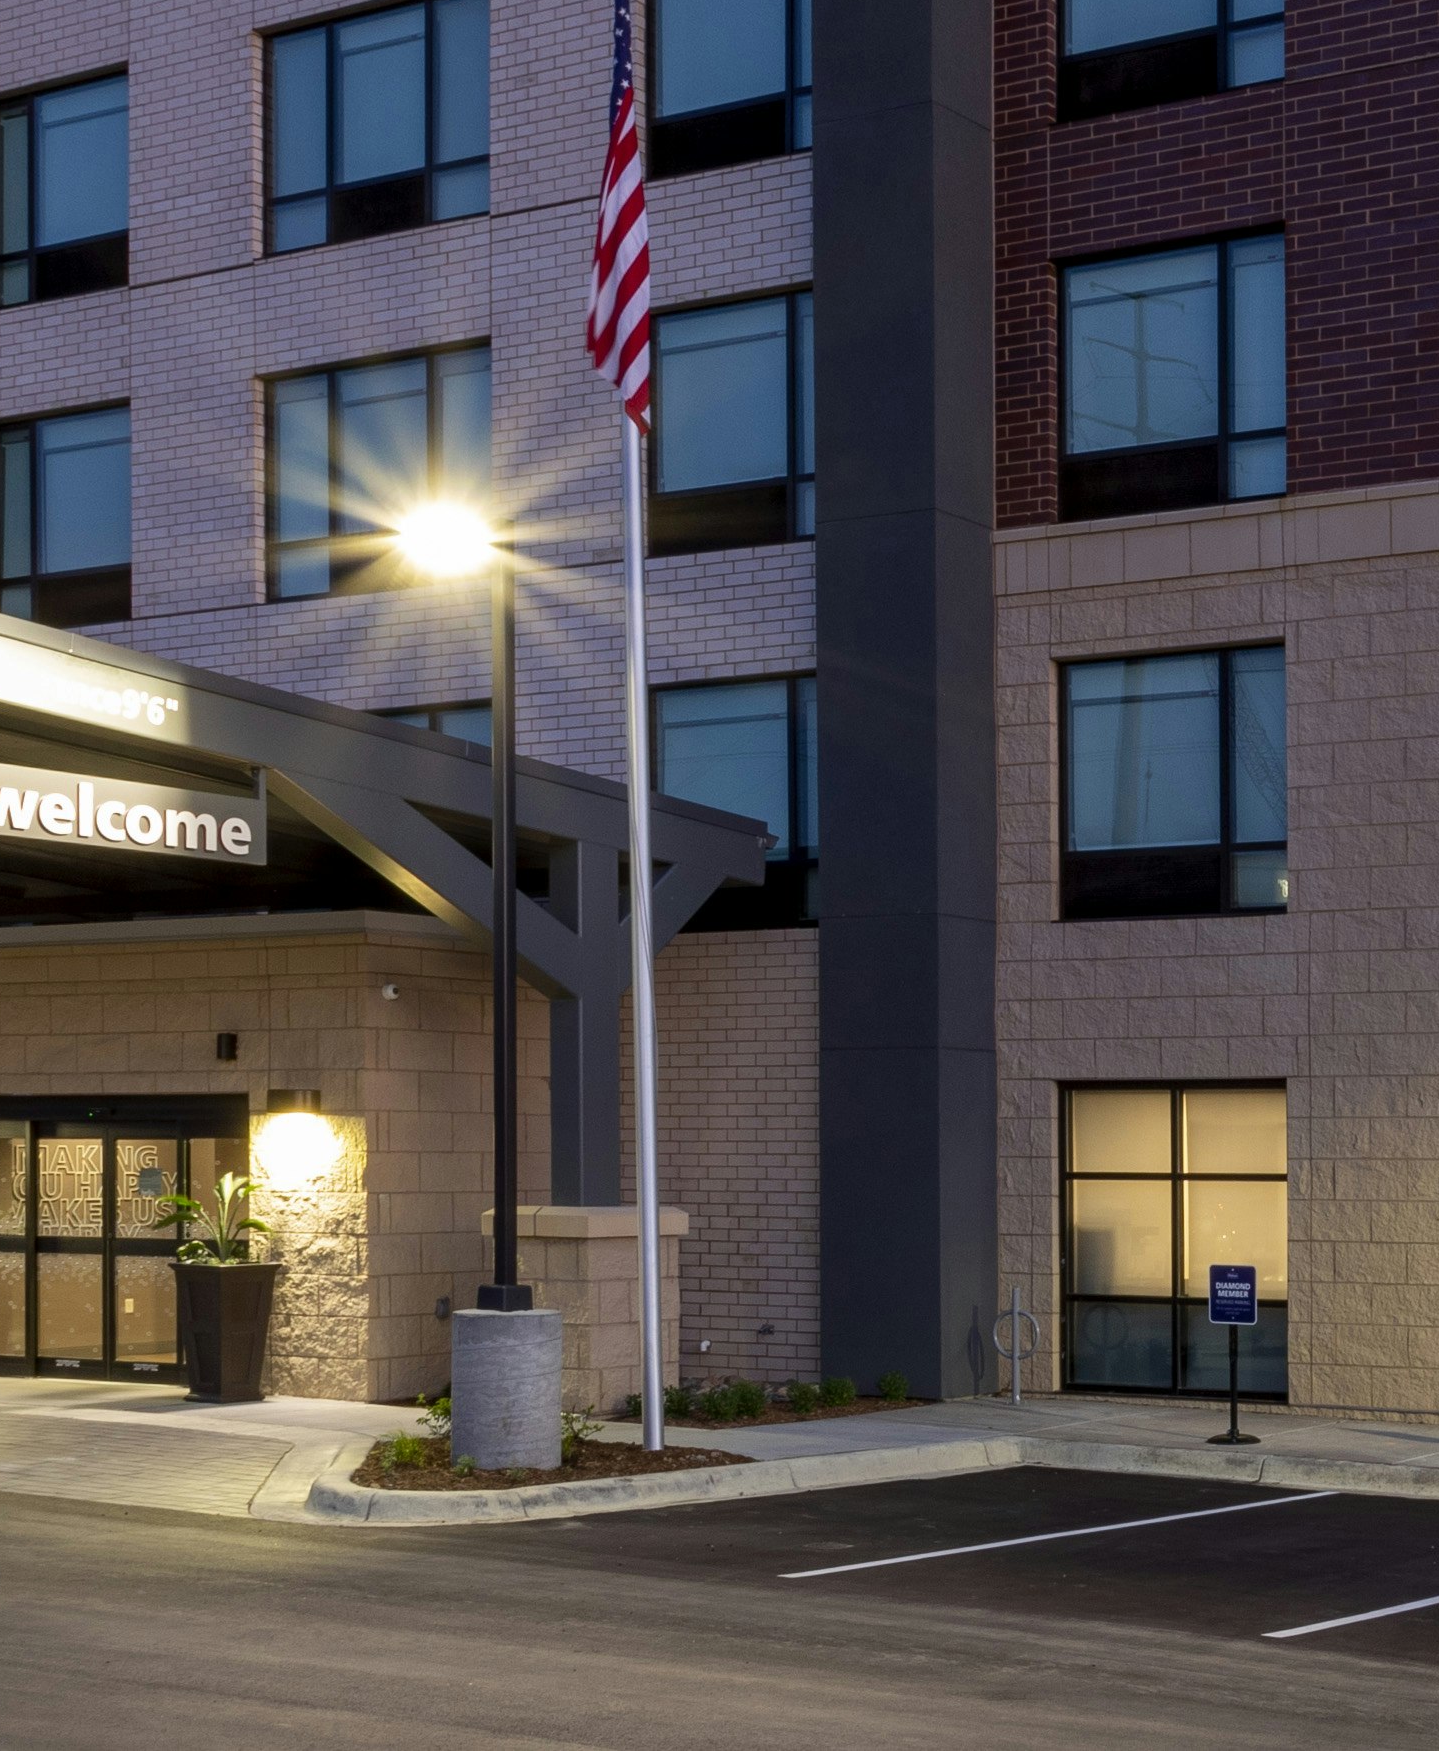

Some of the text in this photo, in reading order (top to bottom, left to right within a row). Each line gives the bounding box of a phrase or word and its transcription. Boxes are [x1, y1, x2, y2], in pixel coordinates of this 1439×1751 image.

[13, 1144, 159, 1174] MAKNG
[12, 1171, 178, 1201] OU HPY
[1215, 1282, 1251, 1290] DIAMOND
[1217, 1290, 1249, 1298] MEMBER
